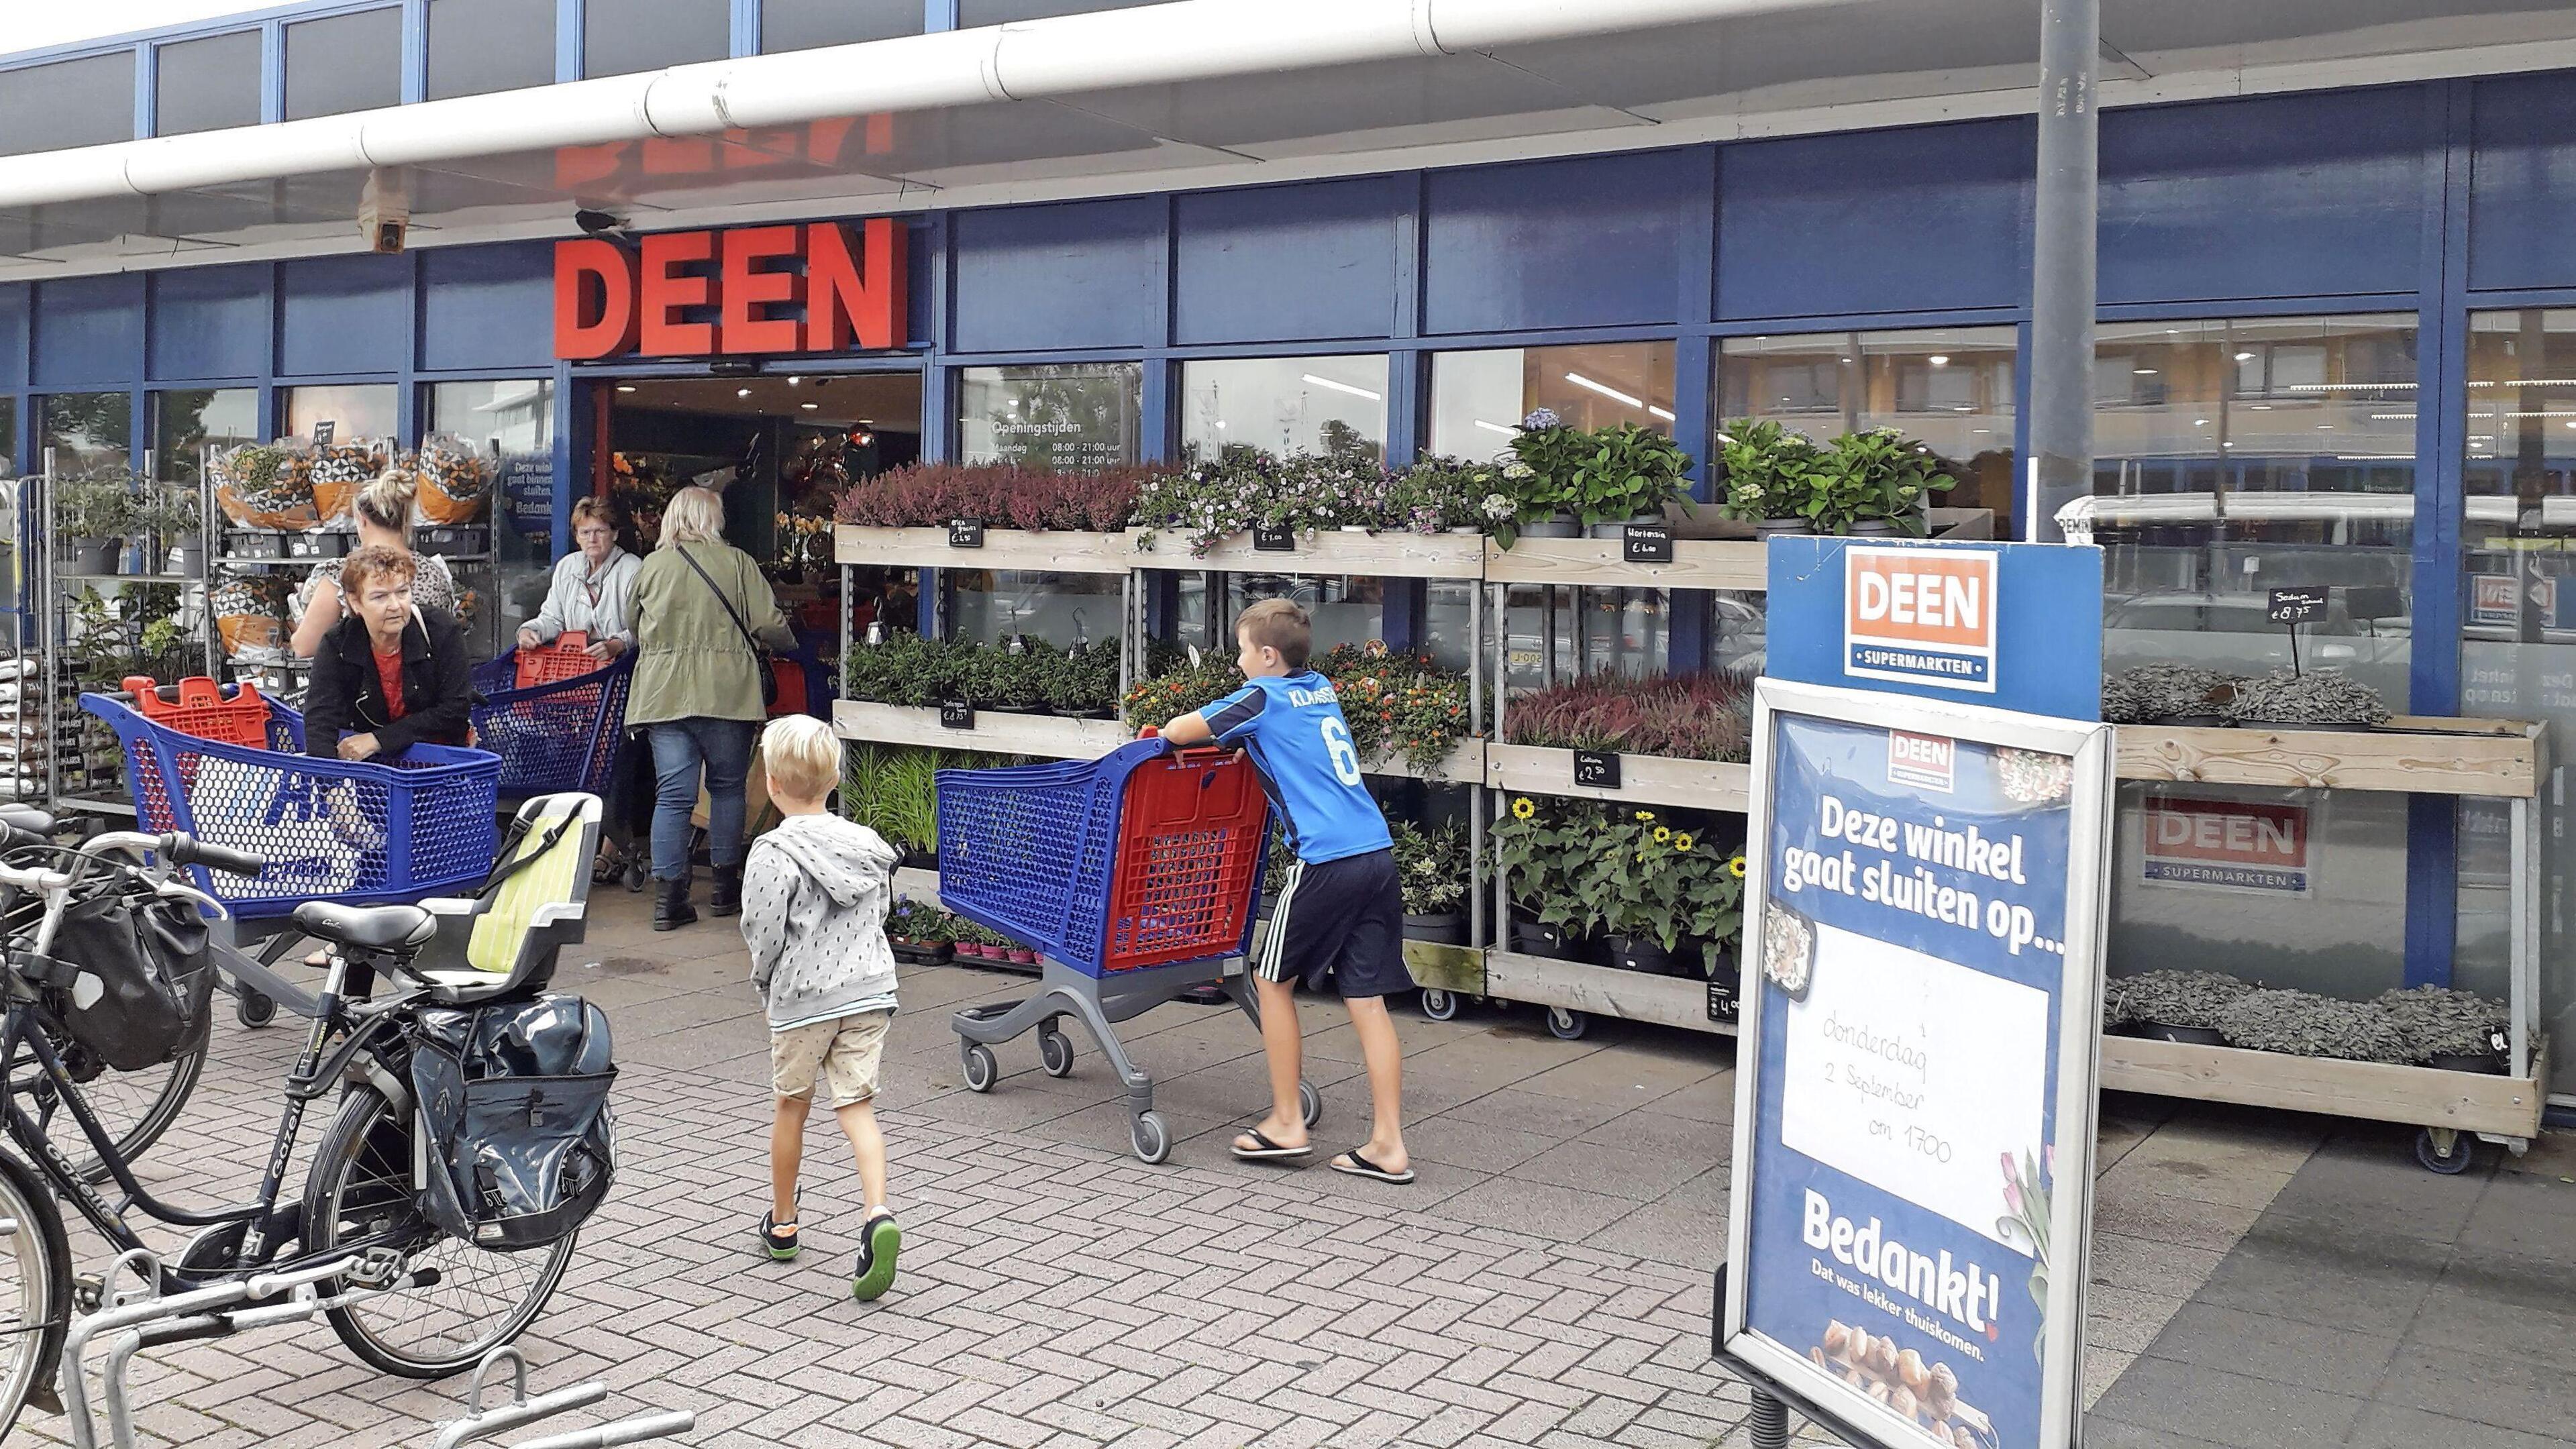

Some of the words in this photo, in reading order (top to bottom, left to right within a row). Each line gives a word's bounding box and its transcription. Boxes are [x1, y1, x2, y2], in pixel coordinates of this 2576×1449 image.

[554, 218, 905, 360] DEEN
[992, 421, 1082, 437] Openingstijden
[1051, 442, 1074, 451] 08:00
[1081, 442, 1105, 451] 21:00
[1051, 455, 1074, 465] 08:00
[1858, 570, 1980, 629] DEEN
[1863, 649, 1973, 676] SUPERMARKTEN
[1321, 716, 1361, 787] 6
[1894, 735, 1949, 767] DEEN
[1820, 794, 1898, 853] Deze
[1904, 816, 2027, 885] winkel
[2157, 810, 2294, 855] DEEN
[1783, 846, 1857, 893] gaat
[1861, 859, 1979, 930] sluiten
[1986, 900, 2066, 956] op...
[2163, 865, 2287, 886] SUPERMARKTEN
[1822, 1009, 1927, 1085] donderdag
[1824, 1062, 1835, 1083] 2
[1846, 1063, 1925, 1111] September
[1869, 1118, 1893, 1141] om
[1904, 1124, 1952, 1163] 1700
[46, 1142, 113, 1221] Gazelle
[1803, 1186, 2000, 1342] Bedankt!
[1811, 1257, 1835, 1284] Dat
[1836, 1271, 1861, 1296] was
[1862, 1281, 1903, 1319] lekker
[1904, 1305, 1986, 1362] thuiskomen.
